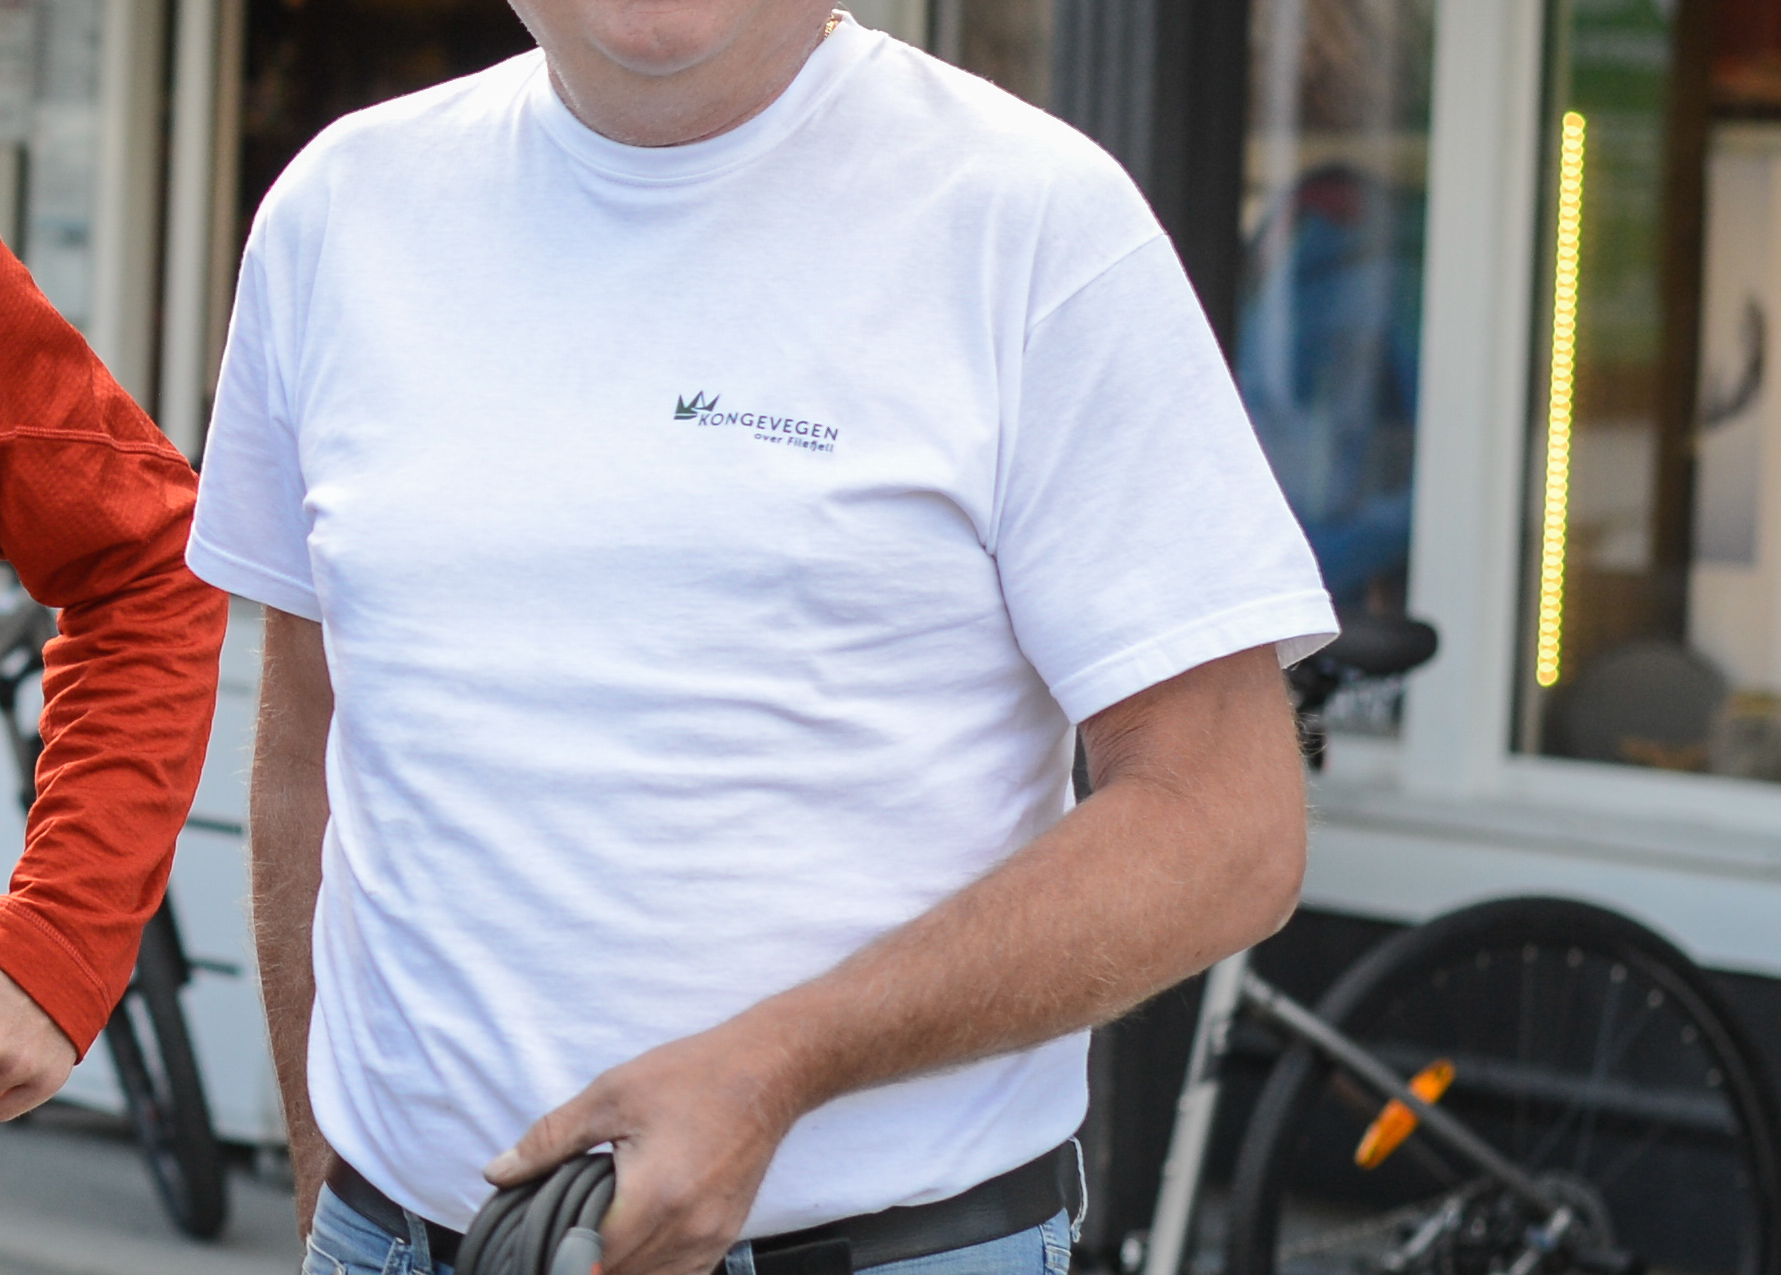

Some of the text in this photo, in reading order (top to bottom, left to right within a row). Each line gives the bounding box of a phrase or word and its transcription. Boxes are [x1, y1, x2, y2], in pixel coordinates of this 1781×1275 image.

[698, 412, 838, 441] KONGEVEGEN
[754, 433, 834, 453] over Filefjell
